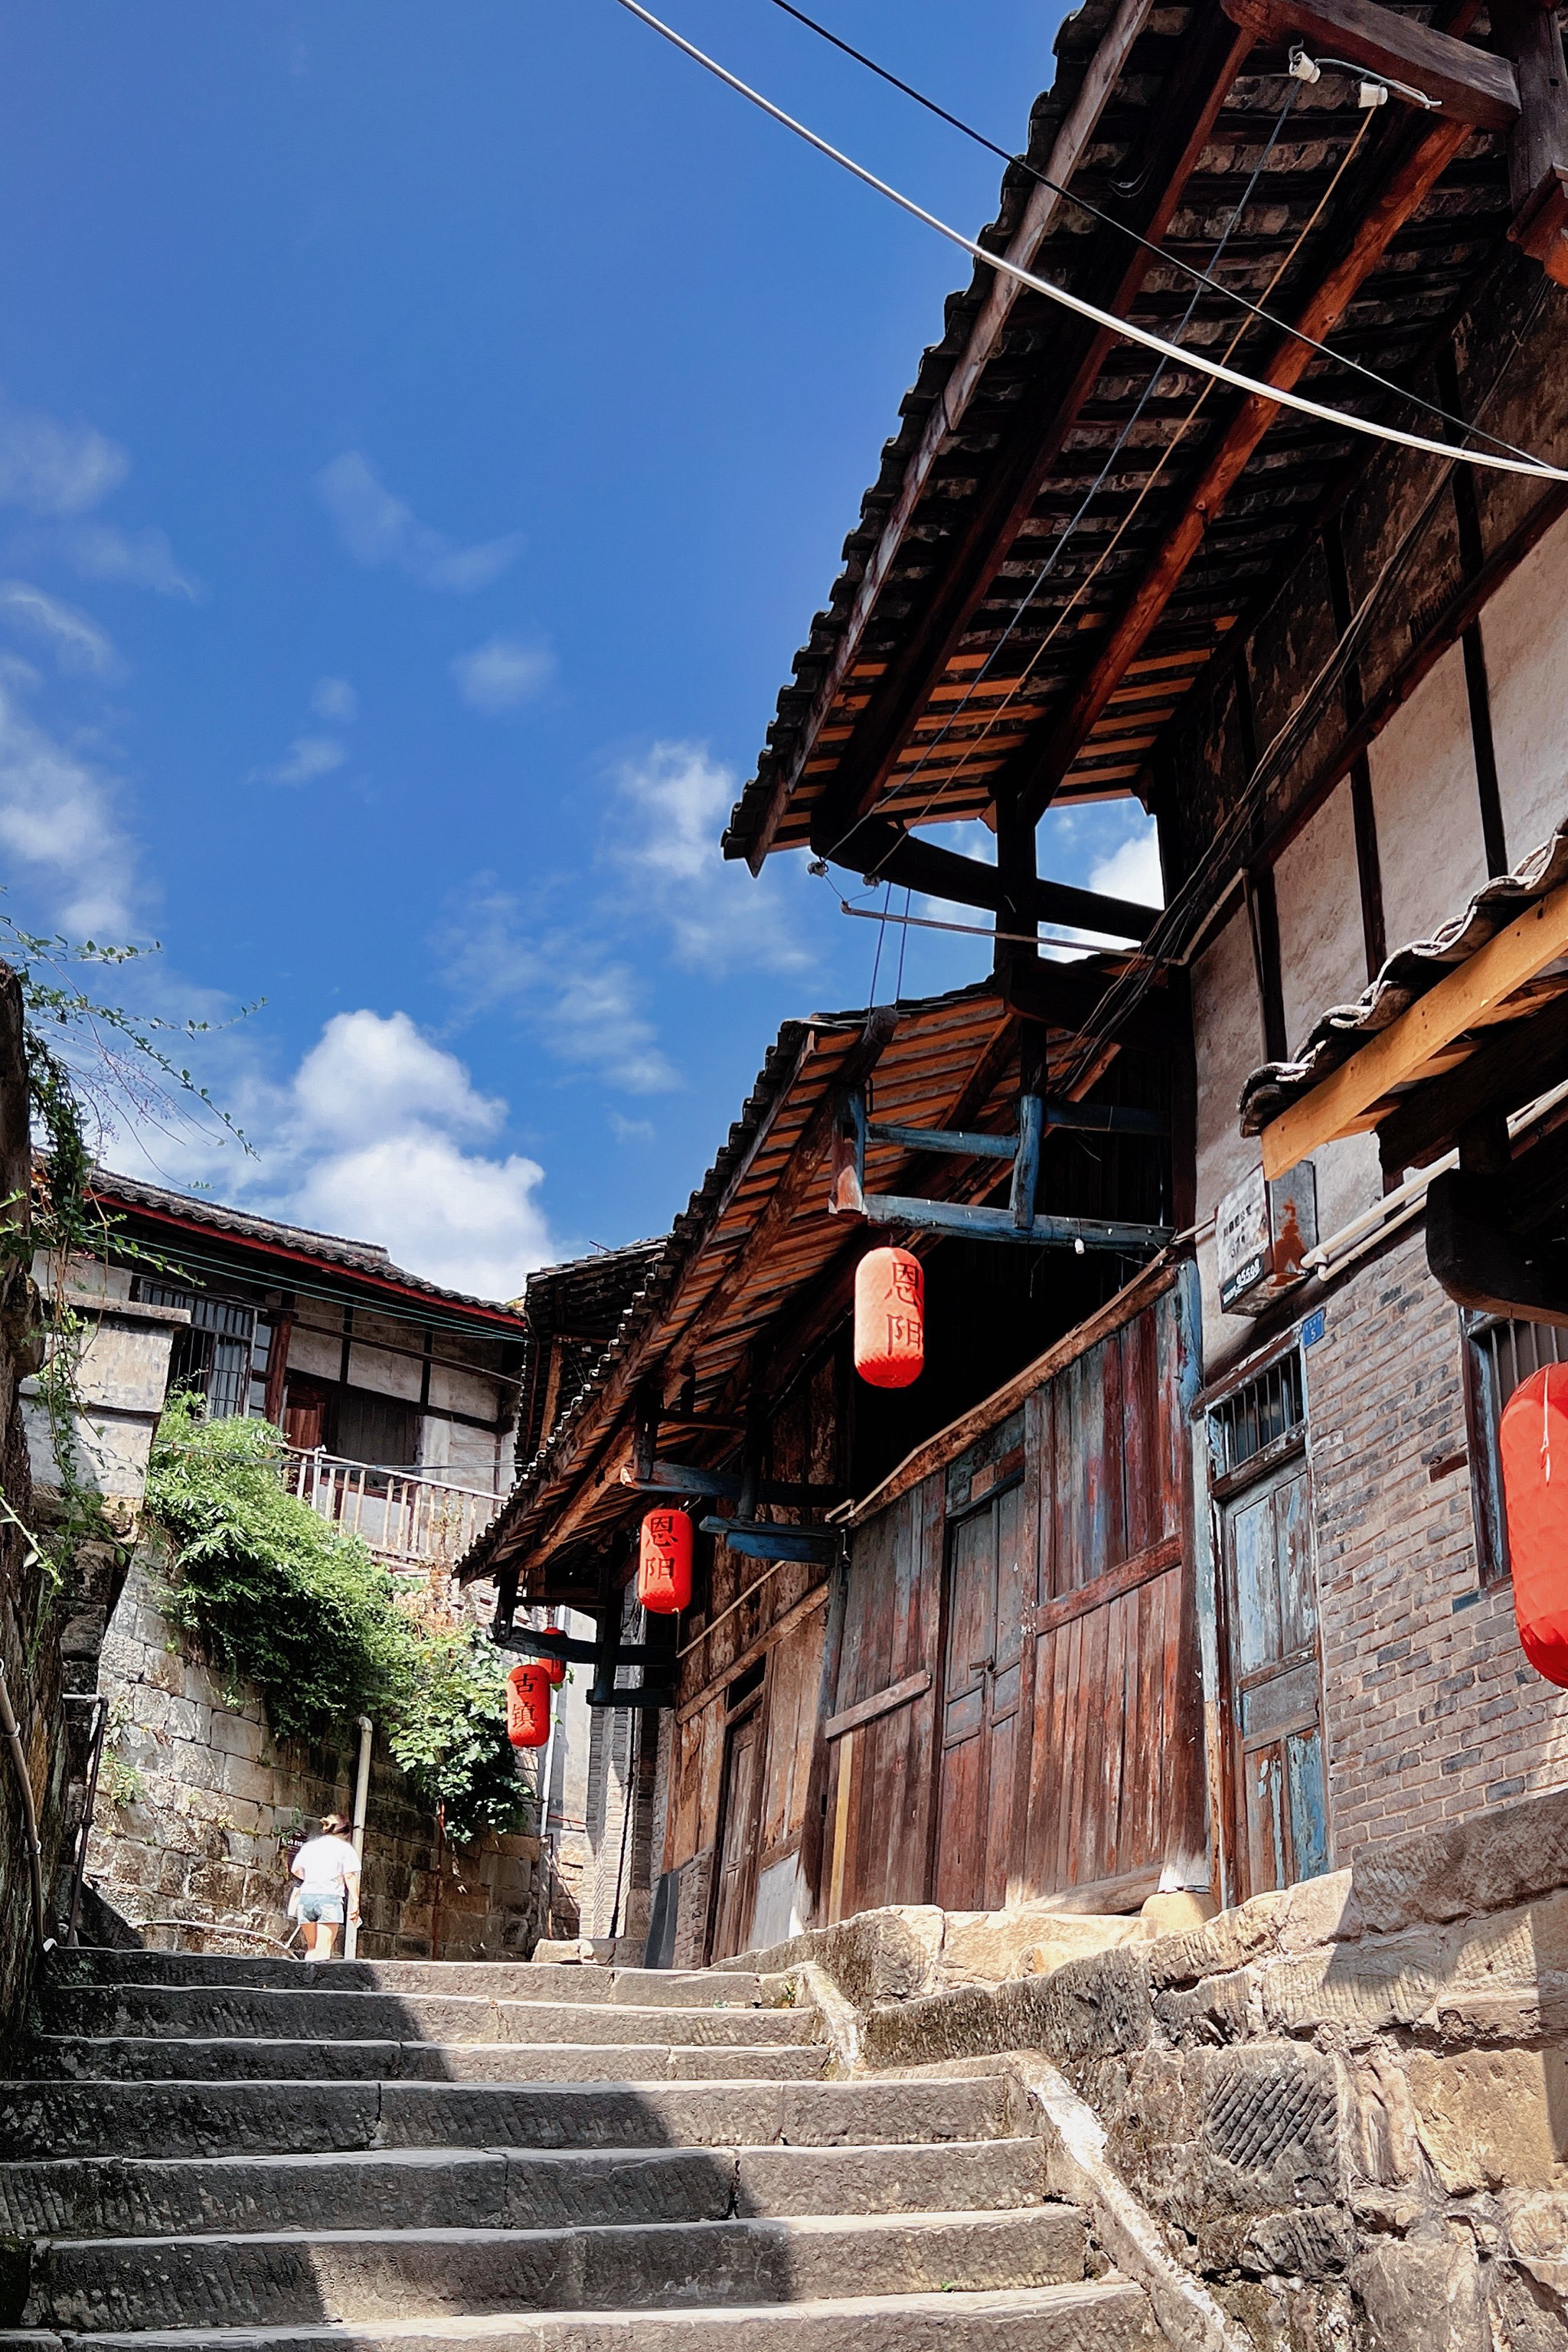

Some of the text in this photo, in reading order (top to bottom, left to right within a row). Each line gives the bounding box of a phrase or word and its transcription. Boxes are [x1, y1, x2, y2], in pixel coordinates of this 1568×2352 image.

[1236, 1258, 1260, 1286] 95598
[884, 1262, 922, 1356] 恩阳
[1311, 1327, 1316, 1340] 5
[645, 1515, 678, 1589] 恩阳
[512, 1673, 538, 1729] 古镇
